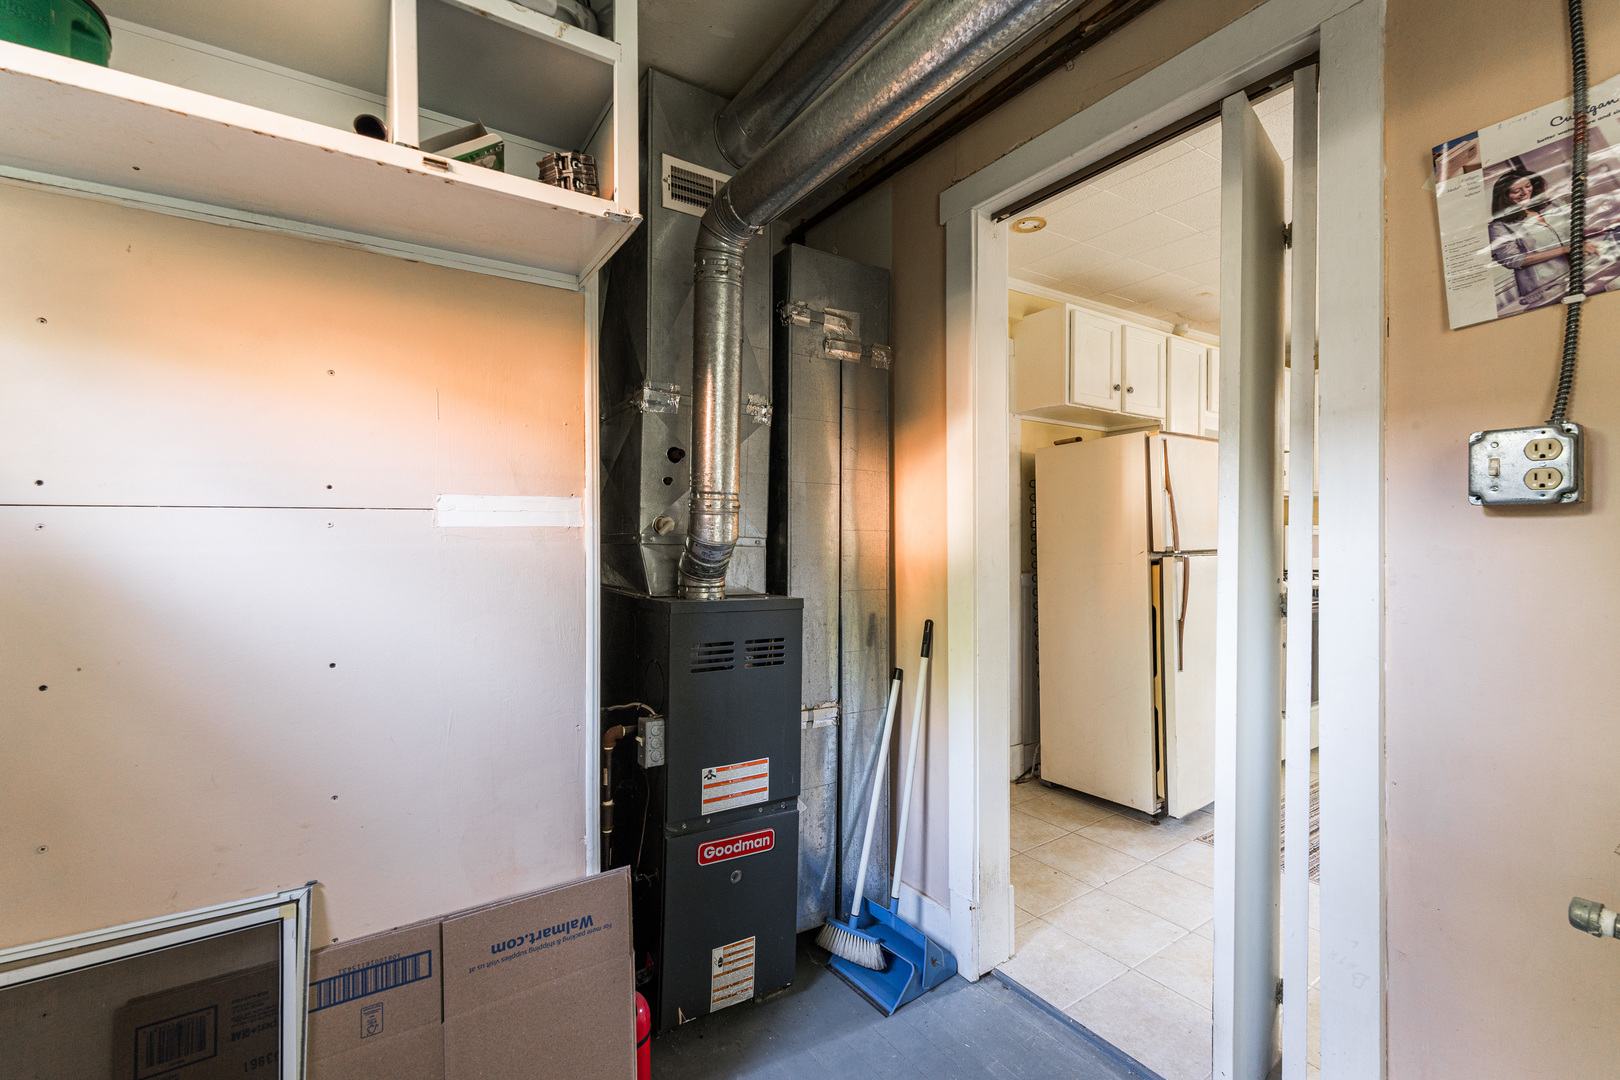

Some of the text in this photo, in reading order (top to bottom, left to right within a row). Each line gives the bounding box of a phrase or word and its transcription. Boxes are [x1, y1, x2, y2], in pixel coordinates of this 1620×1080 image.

[1537, 133, 1556, 143] better
[1596, 112, 1611, 121] and
[703, 836, 770, 859] Goodman
[586, 926, 602, 935] more
[603, 922, 613, 930] For
[491, 915, 594, 955] Walmart.com
[562, 930, 586, 943] packing
[528, 941, 556, 954] shipping
[501, 950, 528, 963] supplies
[468, 966, 476, 974] at
[477, 963, 486, 971] us
[486, 959, 500, 968] visit
